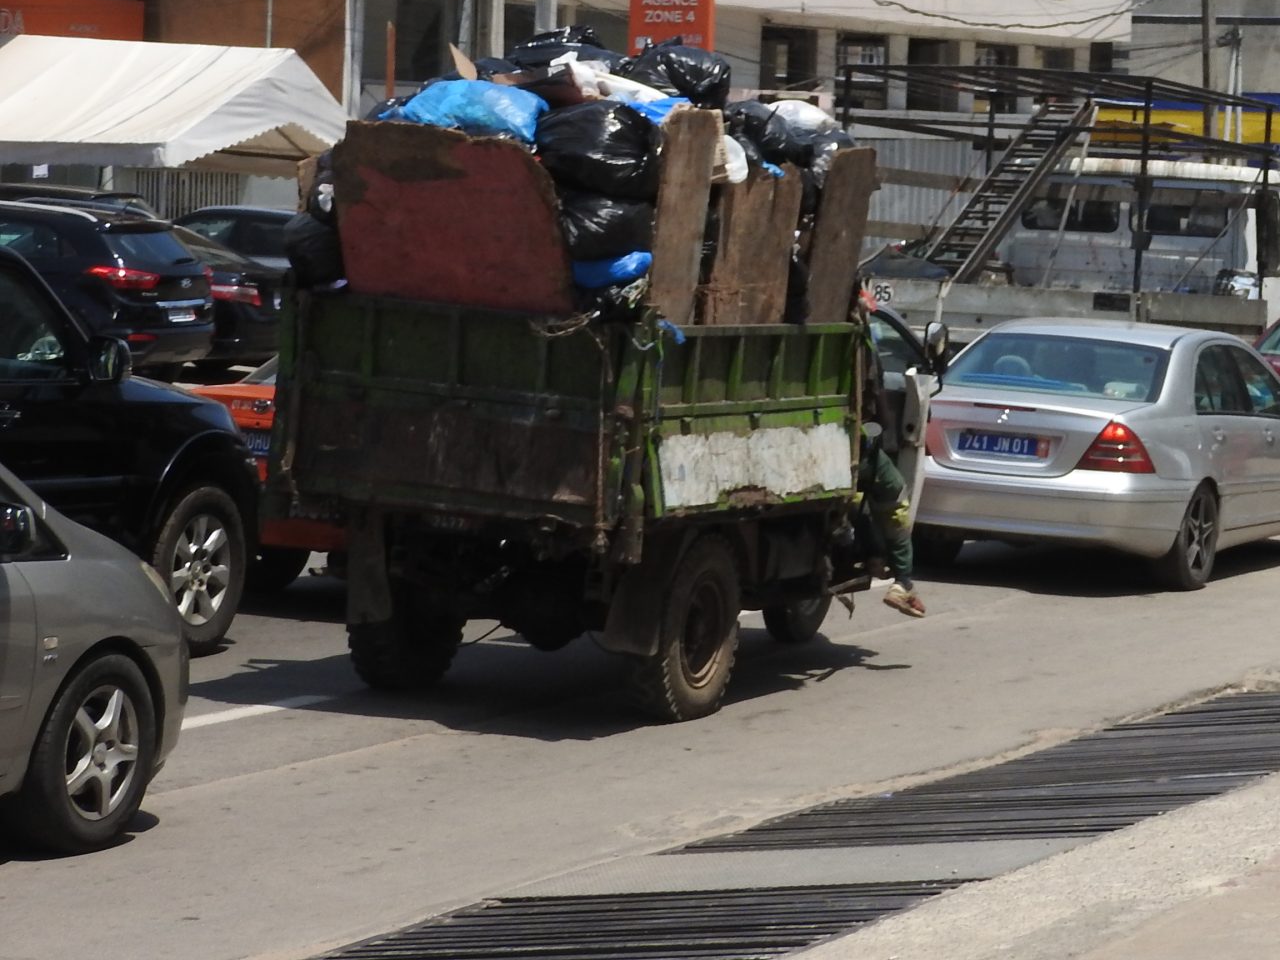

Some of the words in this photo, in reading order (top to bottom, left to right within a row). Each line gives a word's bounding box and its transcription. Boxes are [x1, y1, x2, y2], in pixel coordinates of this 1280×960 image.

[645, 10, 683, 23] ZONE
[686, 11, 695, 23] 4
[874, 284, 891, 302] 85
